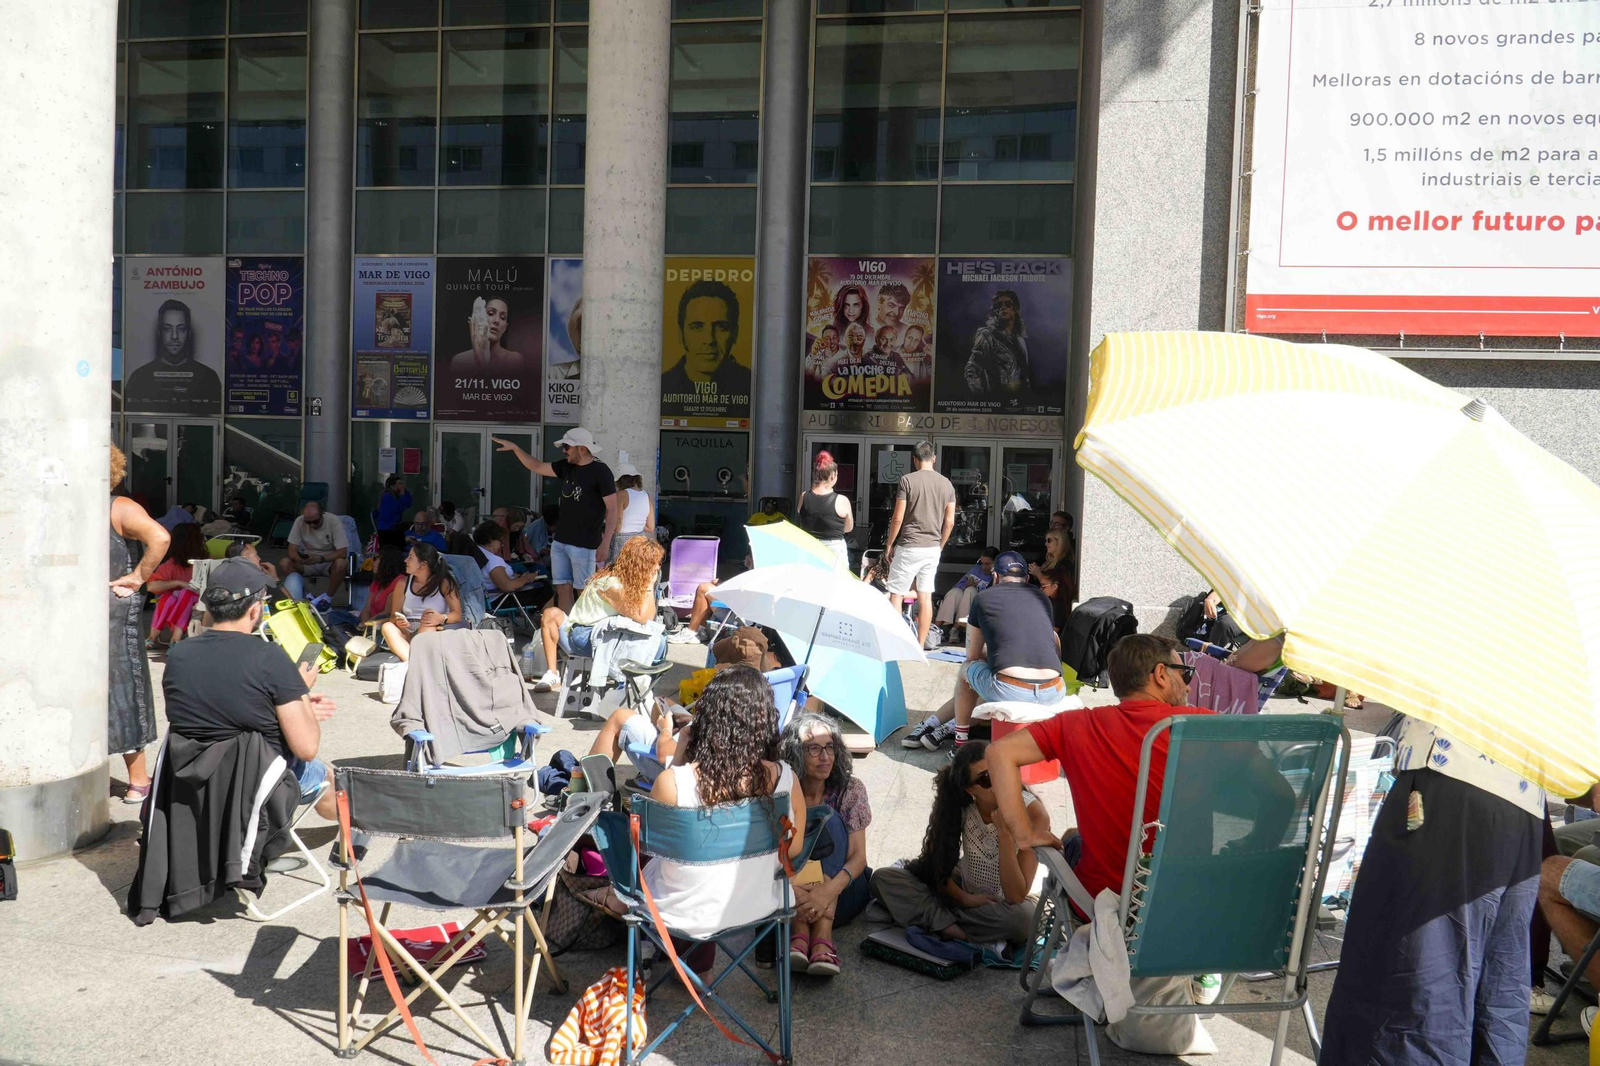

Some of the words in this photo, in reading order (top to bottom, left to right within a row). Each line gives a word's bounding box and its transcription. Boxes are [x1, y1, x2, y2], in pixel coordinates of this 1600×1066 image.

[1414, 32, 1426, 46] 8
[1433, 34, 1489, 46] novos
[1497, 30, 1575, 48] grandes
[1312, 73, 1391, 87] Melloras
[1398, 75, 1421, 86] en
[1428, 71, 1523, 86] dotacións
[1531, 70, 1555, 85] de
[1349, 112, 1434, 126] 900.000
[1442, 112, 1471, 126] m2
[1478, 115, 1500, 126] en
[1508, 114, 1565, 125] novos
[1363, 148, 1387, 163] 1,5
[1394, 147, 1463, 161] millóns
[1470, 148, 1494, 161] de
[1501, 147, 1530, 161] m2
[1538, 149, 1581, 163] para
[1422, 172, 1522, 186] industriais
[1529, 175, 1540, 186] e
[1336, 210, 1358, 231] O
[1368, 210, 1463, 231] mellor
[1472, 210, 1566, 231] futuro
[1576, 215, 1600, 235] p
[147, 265, 203, 276] ANTÓNIO
[858, 260, 886, 273] VIGO
[946, 260, 996, 275] HE'S
[1001, 261, 1063, 275] BACK
[240, 270, 289, 281] TECHNO
[358, 270, 382, 279] MAR
[385, 270, 401, 279] DE
[404, 270, 431, 279] VIGO
[468, 265, 518, 283] MALÚ
[666, 268, 753, 282] DEPEDRO
[962, 274, 989, 283] MICHAEL
[990, 274, 1018, 283] JACKSON
[1019, 274, 1046, 283] TRIBUTE
[144, 280, 205, 290] ZAMBUJO
[446, 283, 482, 291] QUINCE
[485, 283, 511, 291] TOUR
[238, 282, 292, 306] POP
[886, 366, 896, 375] es
[454, 378, 488, 389] 21/11.
[491, 378, 521, 390] VIGO
[548, 383, 575, 393] KIKO
[694, 381, 718, 395] VIGO
[822, 373, 913, 400] COMEDIA
[481, 393, 492, 401] DE
[493, 393, 513, 402] VIGO
[662, 393, 700, 403] AUDITORIO
[702, 394, 718, 404] MAR
[720, 394, 729, 404] DE
[731, 395, 749, 405] VIGO
[808, 413, 891, 429] AUDIRIO
[897, 416, 934, 429] PAZO
[941, 416, 961, 430] DE
[966, 417, 1061, 433] CONGRESOS
[674, 437, 733, 449] TAQUILLA
